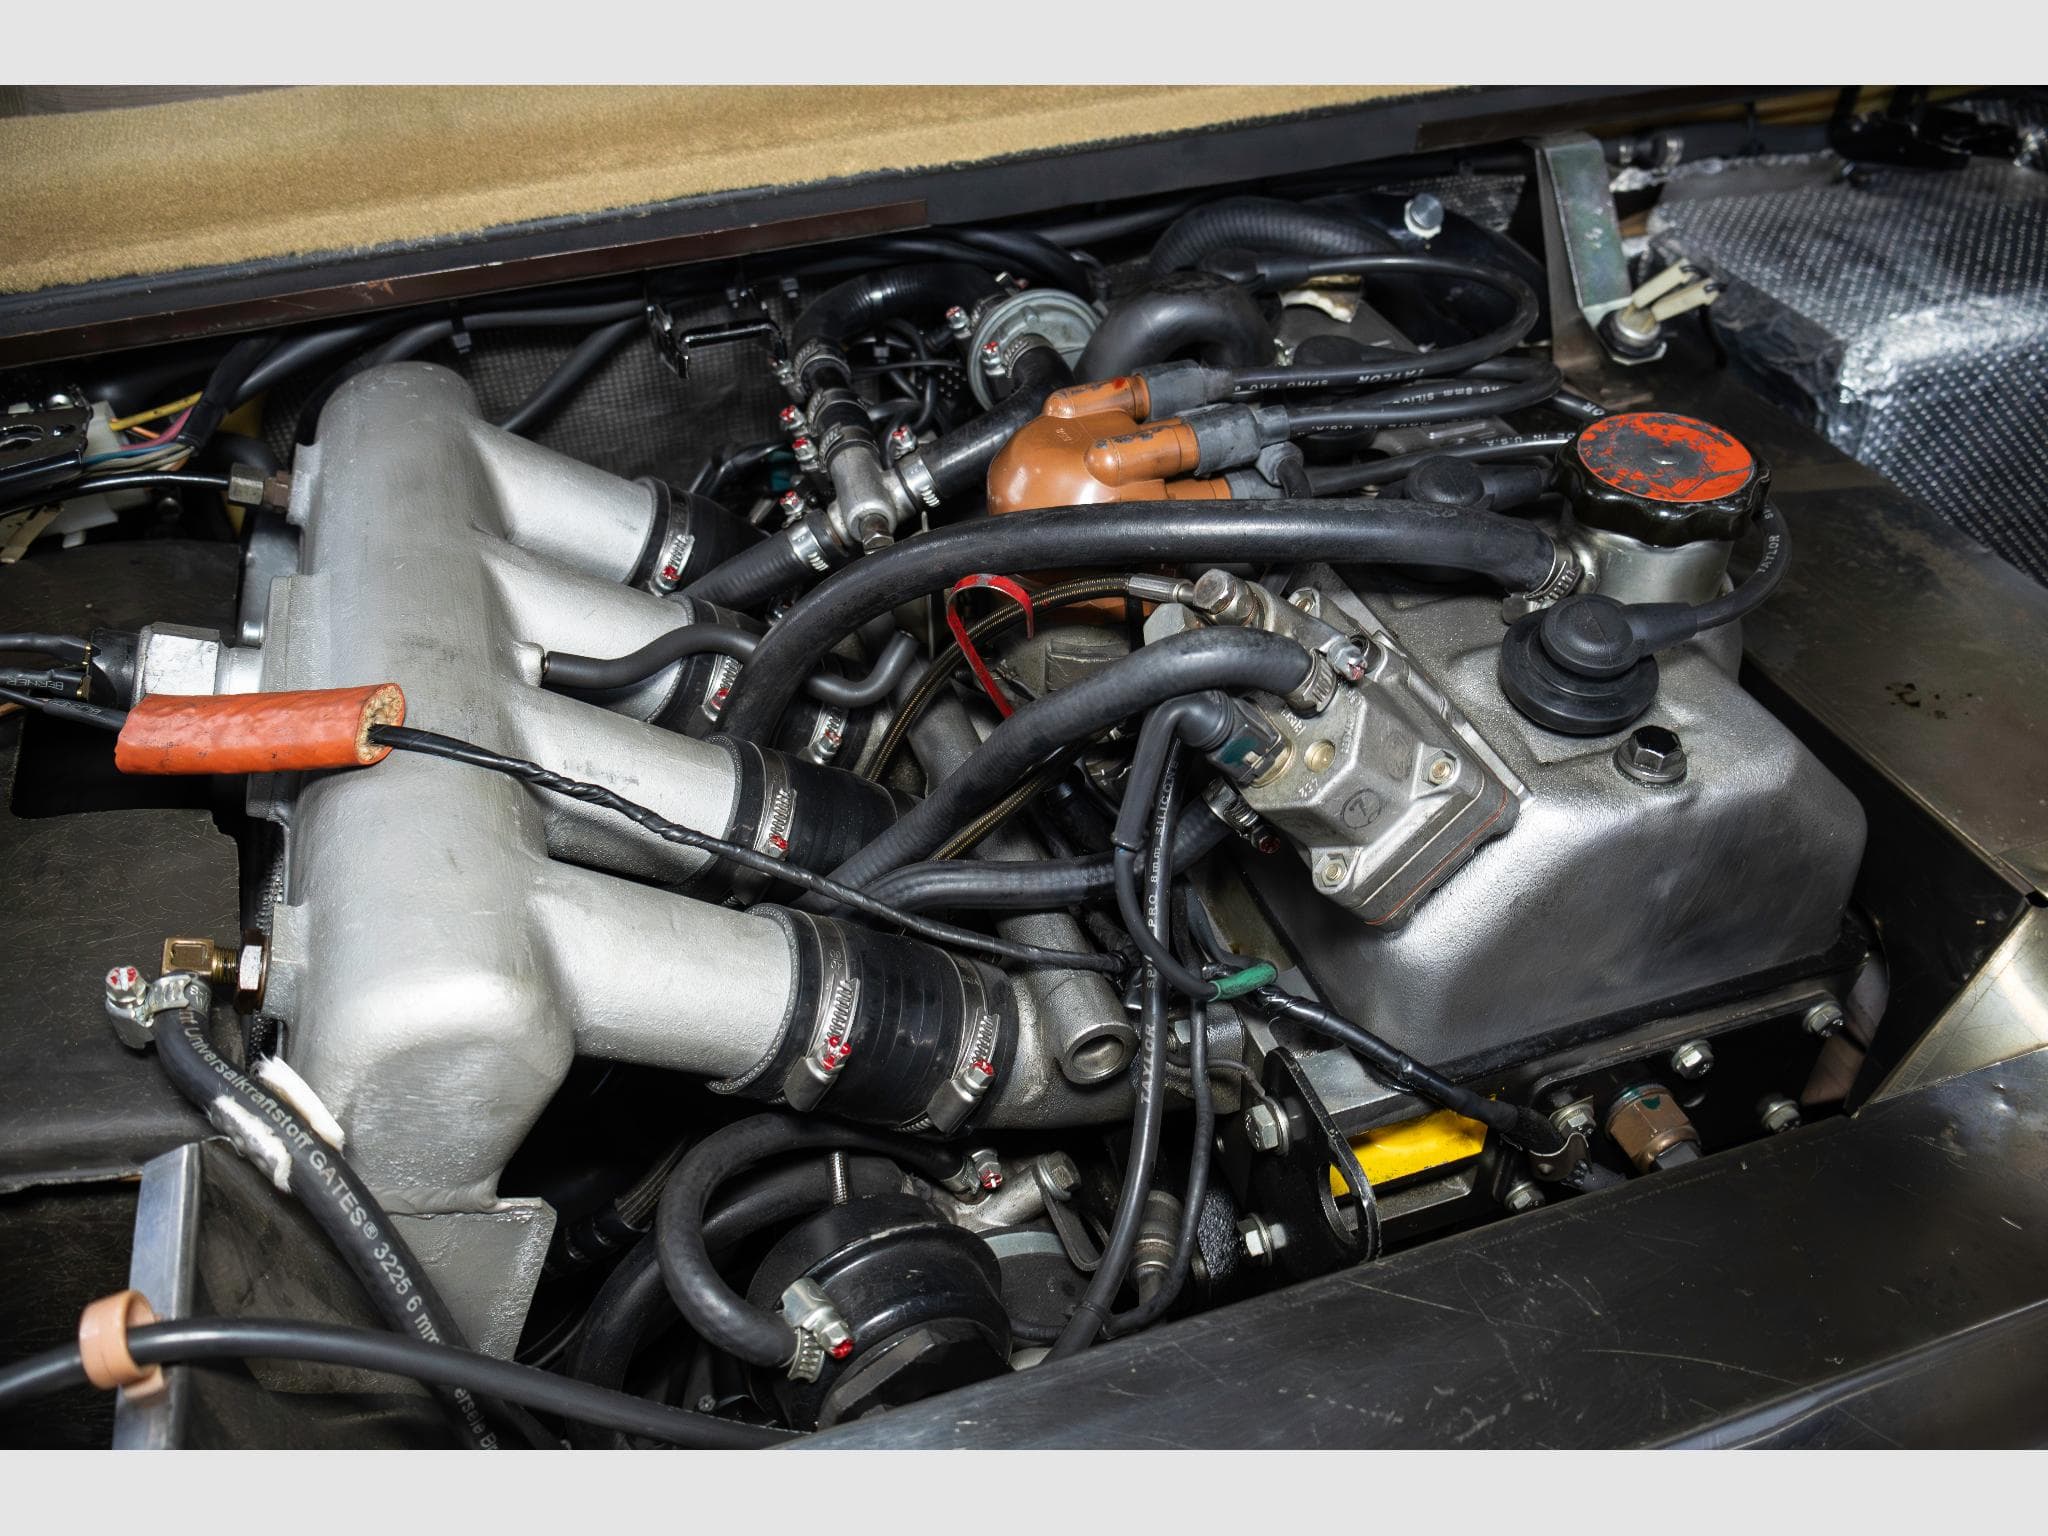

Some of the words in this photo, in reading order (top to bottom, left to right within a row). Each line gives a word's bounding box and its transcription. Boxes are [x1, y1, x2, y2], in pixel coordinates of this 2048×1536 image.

[1356, 368, 1425, 384] TAYLOR
[1482, 436, 1523, 447] U.S.A.
[1533, 433, 1547, 441] IN
[1758, 534, 1780, 573] TAYLOR
[6, 676, 64, 691] BERNER
[1155, 760, 1178, 835] SILICONE
[1150, 847, 1161, 884] 8mm
[1148, 894, 1158, 928] PRO
[1140, 1023, 1156, 1104] TAYLOR
[373, 1242, 413, 1295] 3225
[405, 1295, 423, 1312] 6
[454, 1387, 486, 1434] ersele
